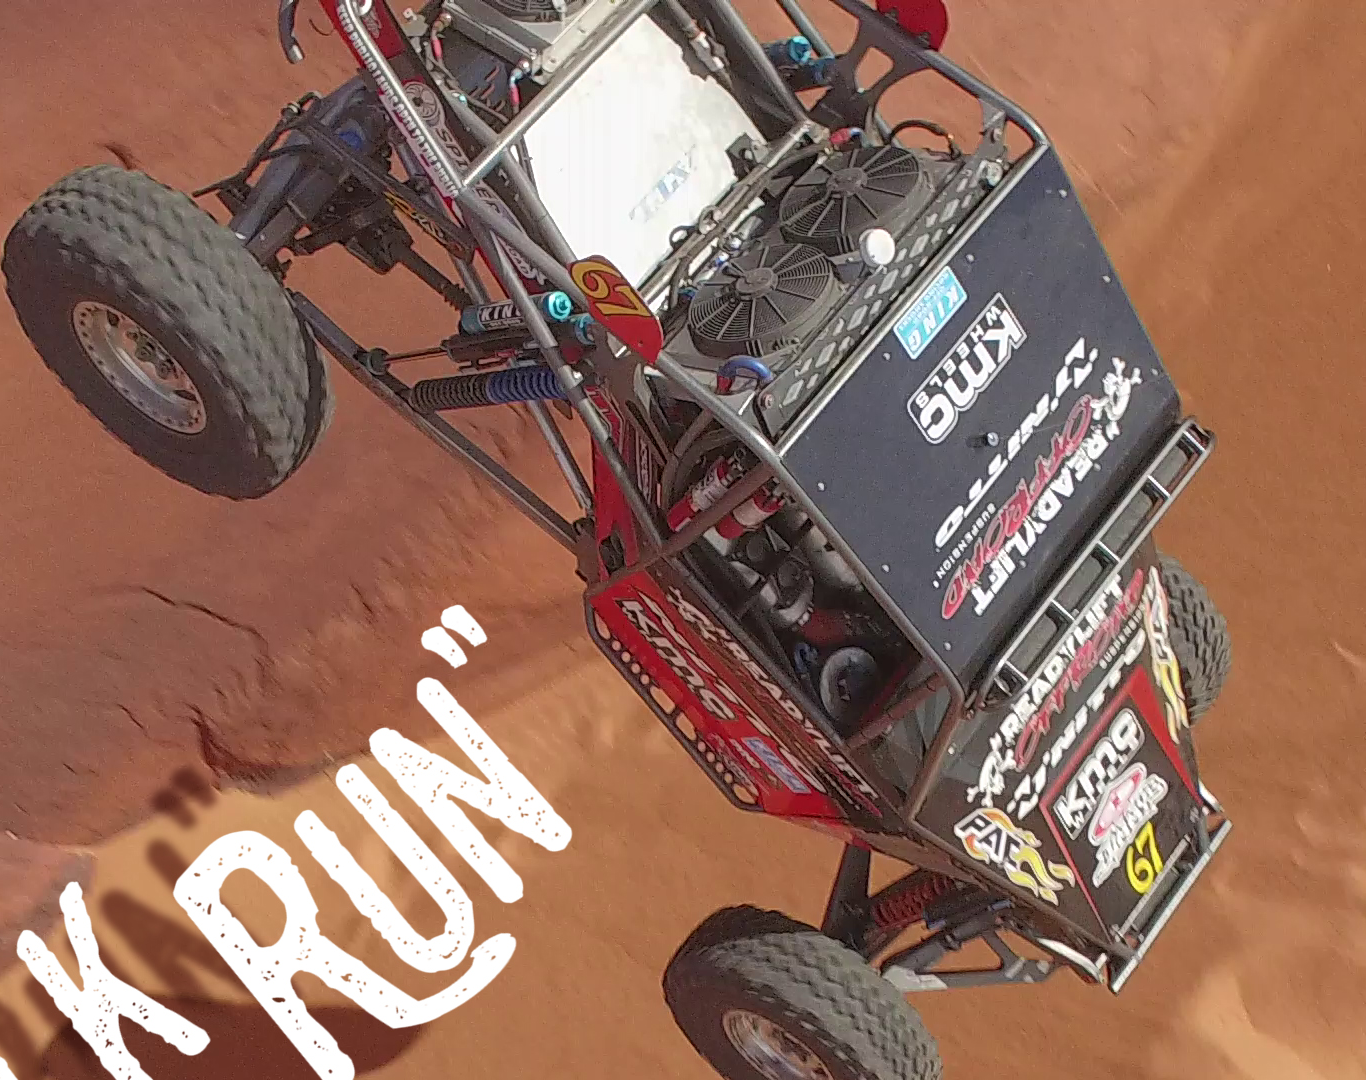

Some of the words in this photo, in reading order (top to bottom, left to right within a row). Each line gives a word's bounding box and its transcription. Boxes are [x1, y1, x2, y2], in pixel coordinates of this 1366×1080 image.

[572, 262, 649, 317] 67
[904, 285, 961, 353] KING
[912, 305, 1003, 410] WHEELS
[934, 502, 998, 580] SUSPENSION
[963, 426, 1110, 617] READYLIFT
[1120, 819, 1166, 897] 67
